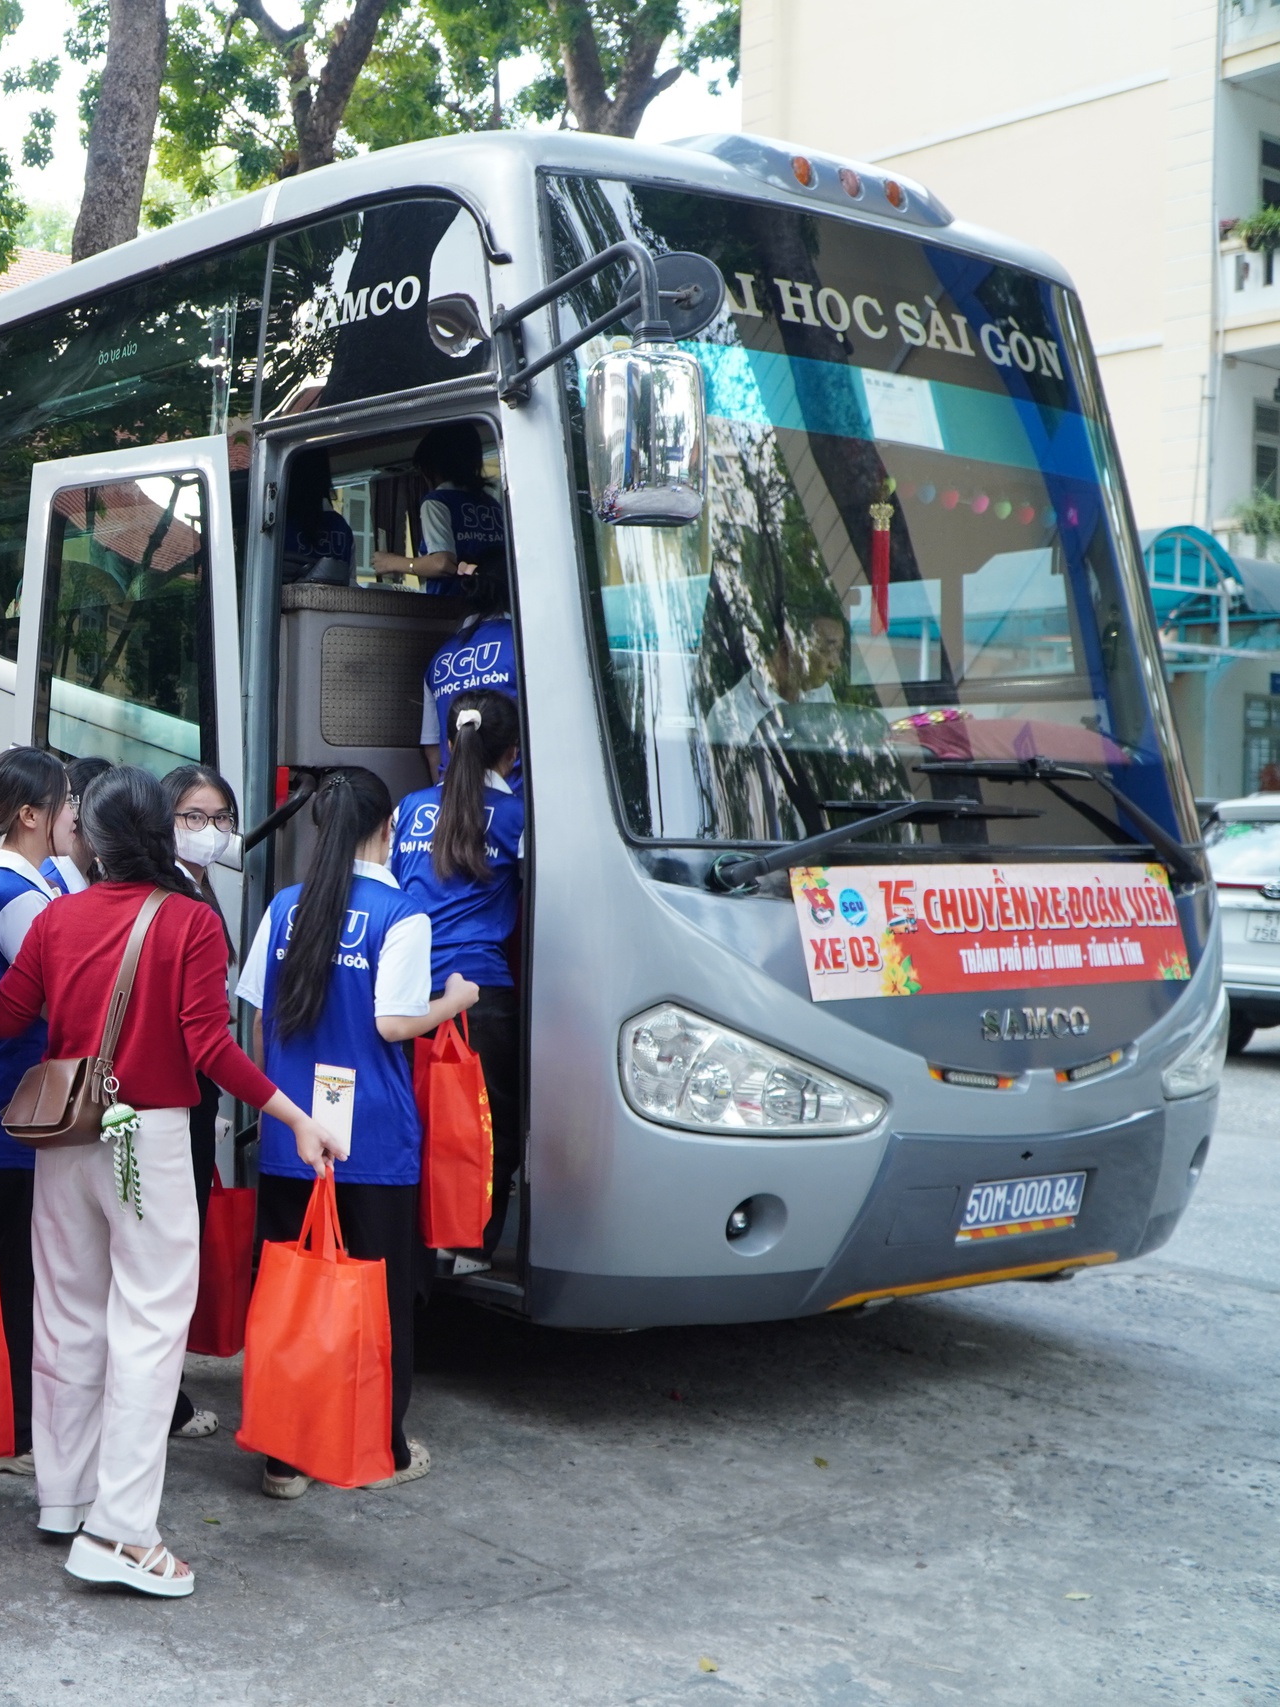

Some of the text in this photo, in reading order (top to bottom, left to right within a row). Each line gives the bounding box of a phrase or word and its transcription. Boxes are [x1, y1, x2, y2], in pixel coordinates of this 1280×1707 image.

[301, 275, 421, 334] SAMCO
[773, 277, 888, 343] HỌC
[895, 295, 976, 357] SÀI
[980, 316, 1064, 381] GÒN
[434, 641, 501, 684] SGU
[441, 681, 460, 695] HỌC
[463, 674, 480, 689] SÀI
[482, 670, 509, 684] GÒN
[841, 901, 865, 913] SGU
[1033, 886, 1065, 929] XE
[1124, 878, 1177, 927] VIÊN
[810, 935, 881, 973] XE 03
[959, 942, 999, 974] THÀNH
[981, 1005, 1090, 1041] SAMCO
[965, 1177, 1078, 1224] 50M-000.84
